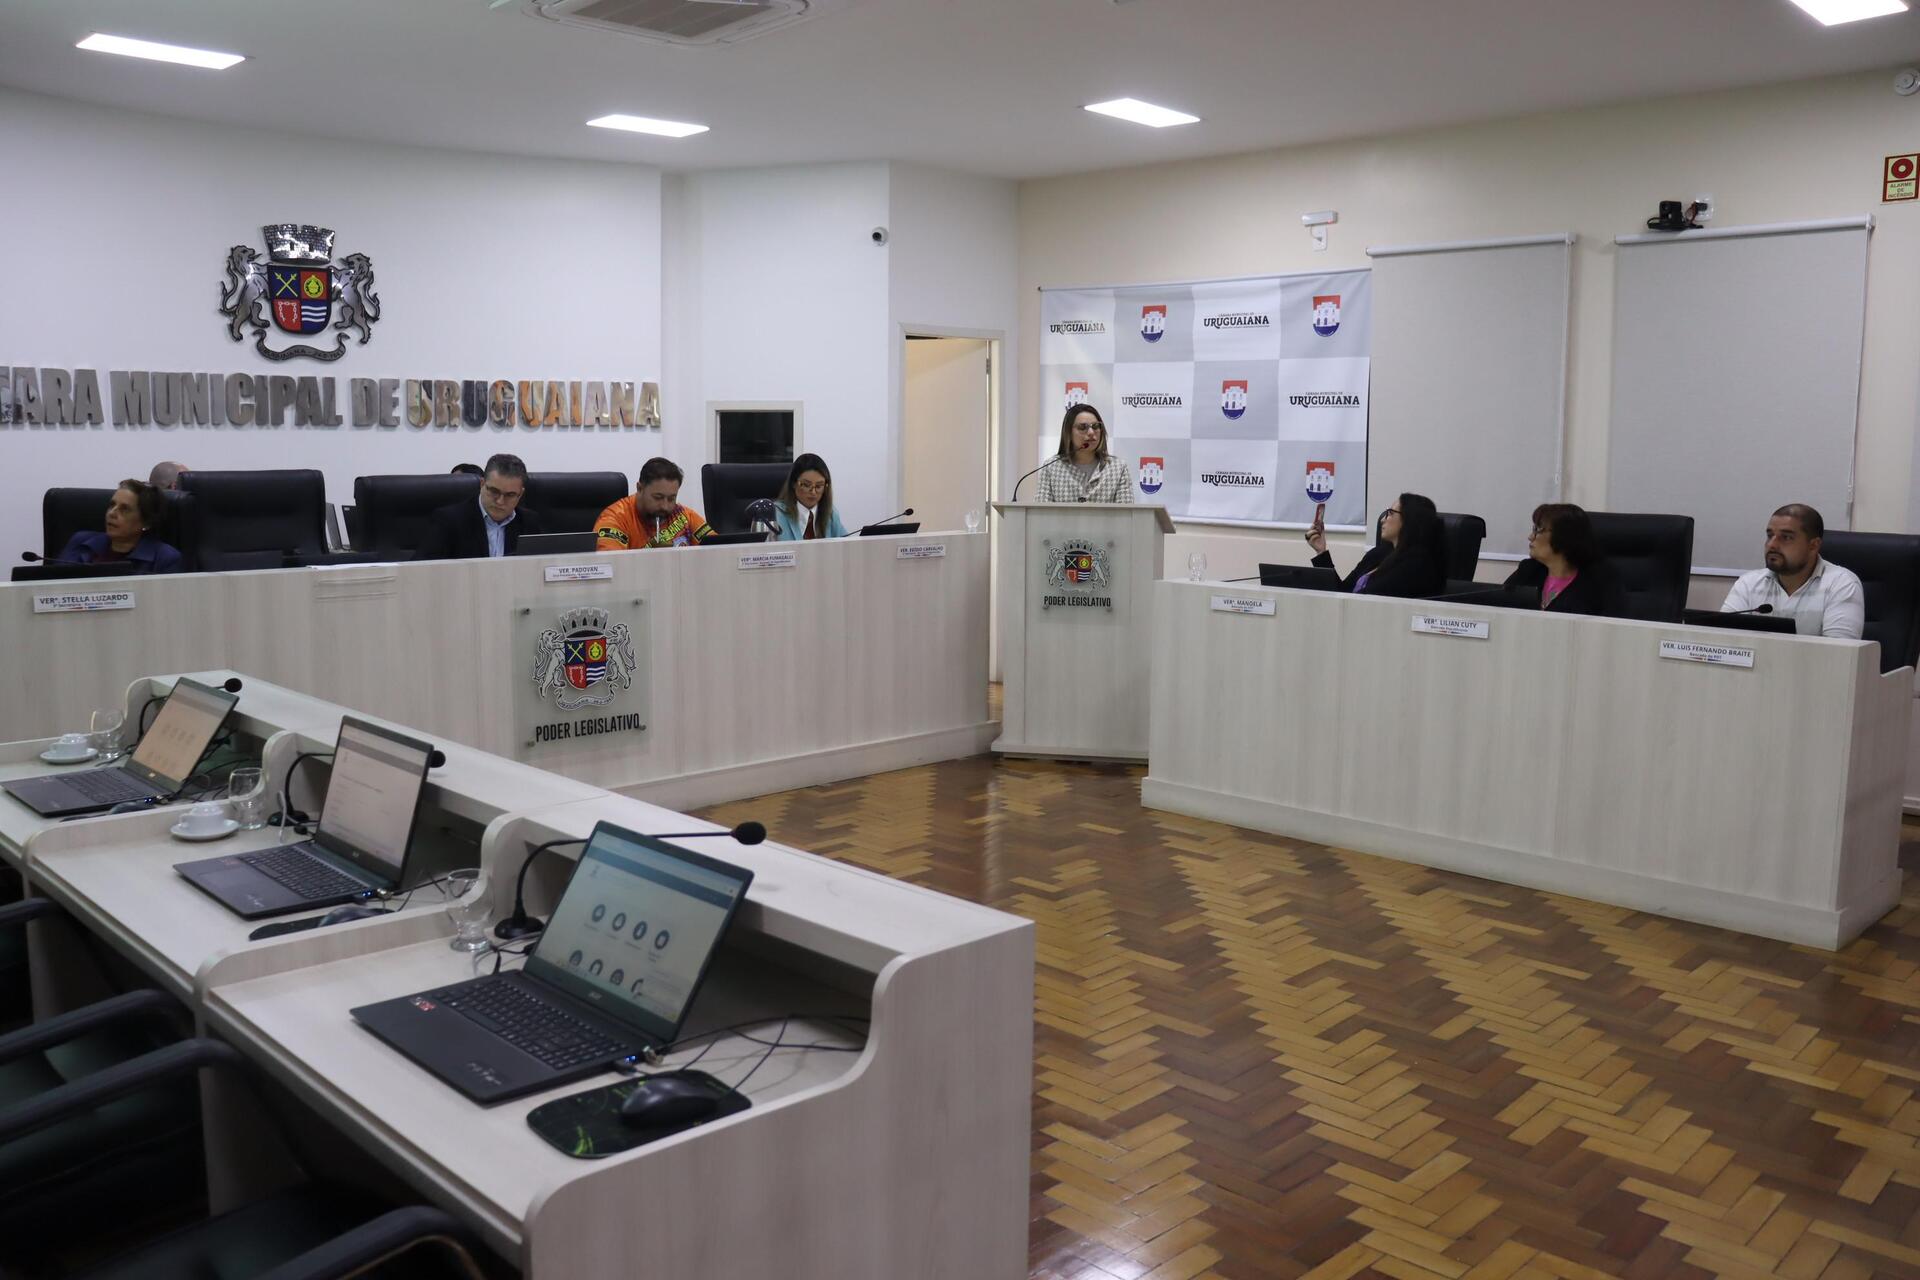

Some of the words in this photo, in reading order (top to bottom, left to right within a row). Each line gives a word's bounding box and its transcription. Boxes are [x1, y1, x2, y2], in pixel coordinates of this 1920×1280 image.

[1050, 322, 1105, 334] URUGUAIANA
[1204, 315, 1270, 329] URUGUAIANA
[0, 366, 104, 425] ARA
[109, 371, 343, 427] MUNICIPAL
[351, 378, 400, 428] DE
[406, 379, 661, 428] URUGUAIANA
[1122, 396, 1182, 408] URUGUAIANA
[1290, 396, 1360, 408] URUGUAIANA
[1202, 474, 1264, 486] URUGUAIANA
[1044, 596, 1066, 606] PODER
[1068, 596, 1111, 607] LEGISLATIVO
[1692, 646, 1727, 654] FERNANDO
[536, 722, 570, 743] PODER
[574, 713, 640, 737] LEGISLATIVO
